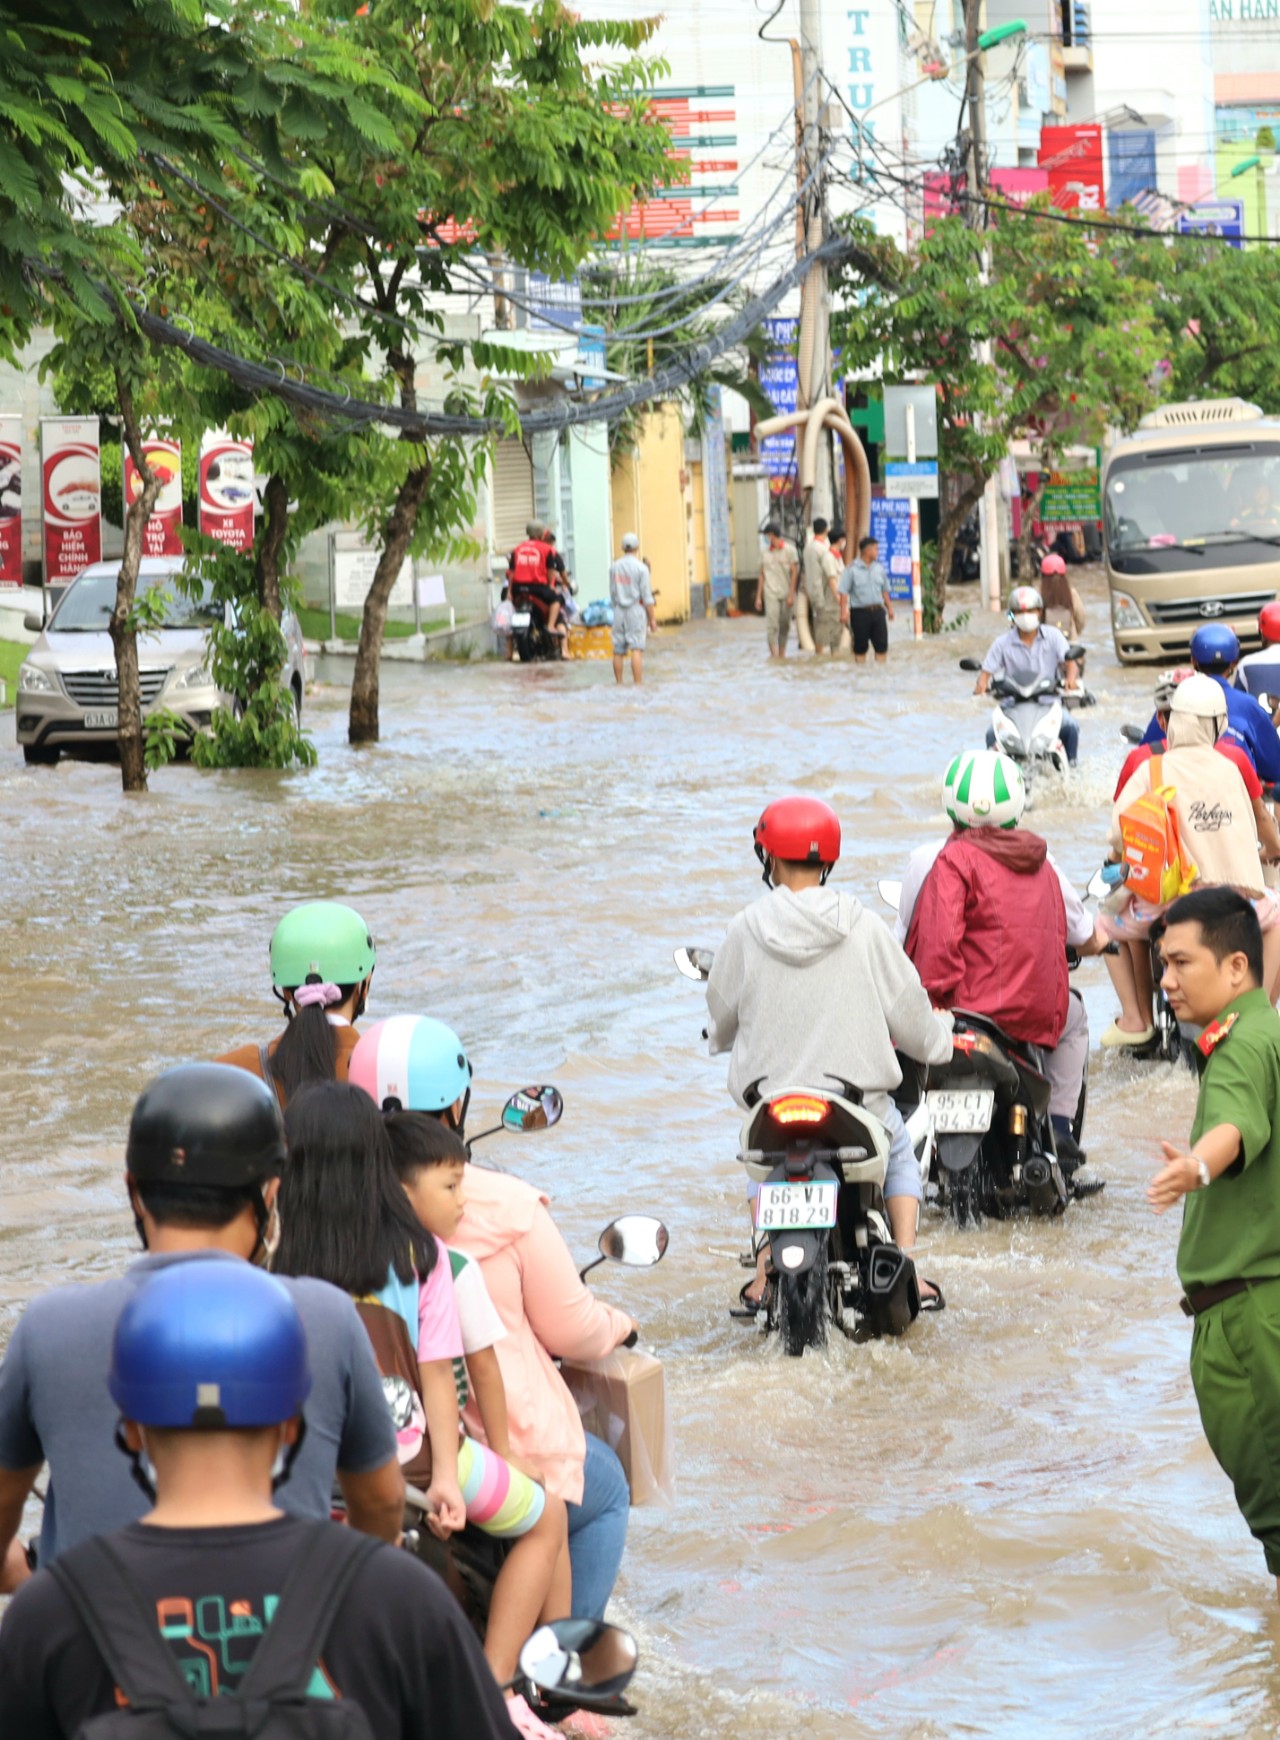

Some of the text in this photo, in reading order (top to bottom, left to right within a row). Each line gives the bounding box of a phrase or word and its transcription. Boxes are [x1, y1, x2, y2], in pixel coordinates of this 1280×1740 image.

[222, 518, 234, 529] XE
[211, 528, 247, 540] TOYOTA
[770, 1186, 824, 1205] 66-V1
[763, 1206, 830, 1226] 818.29
